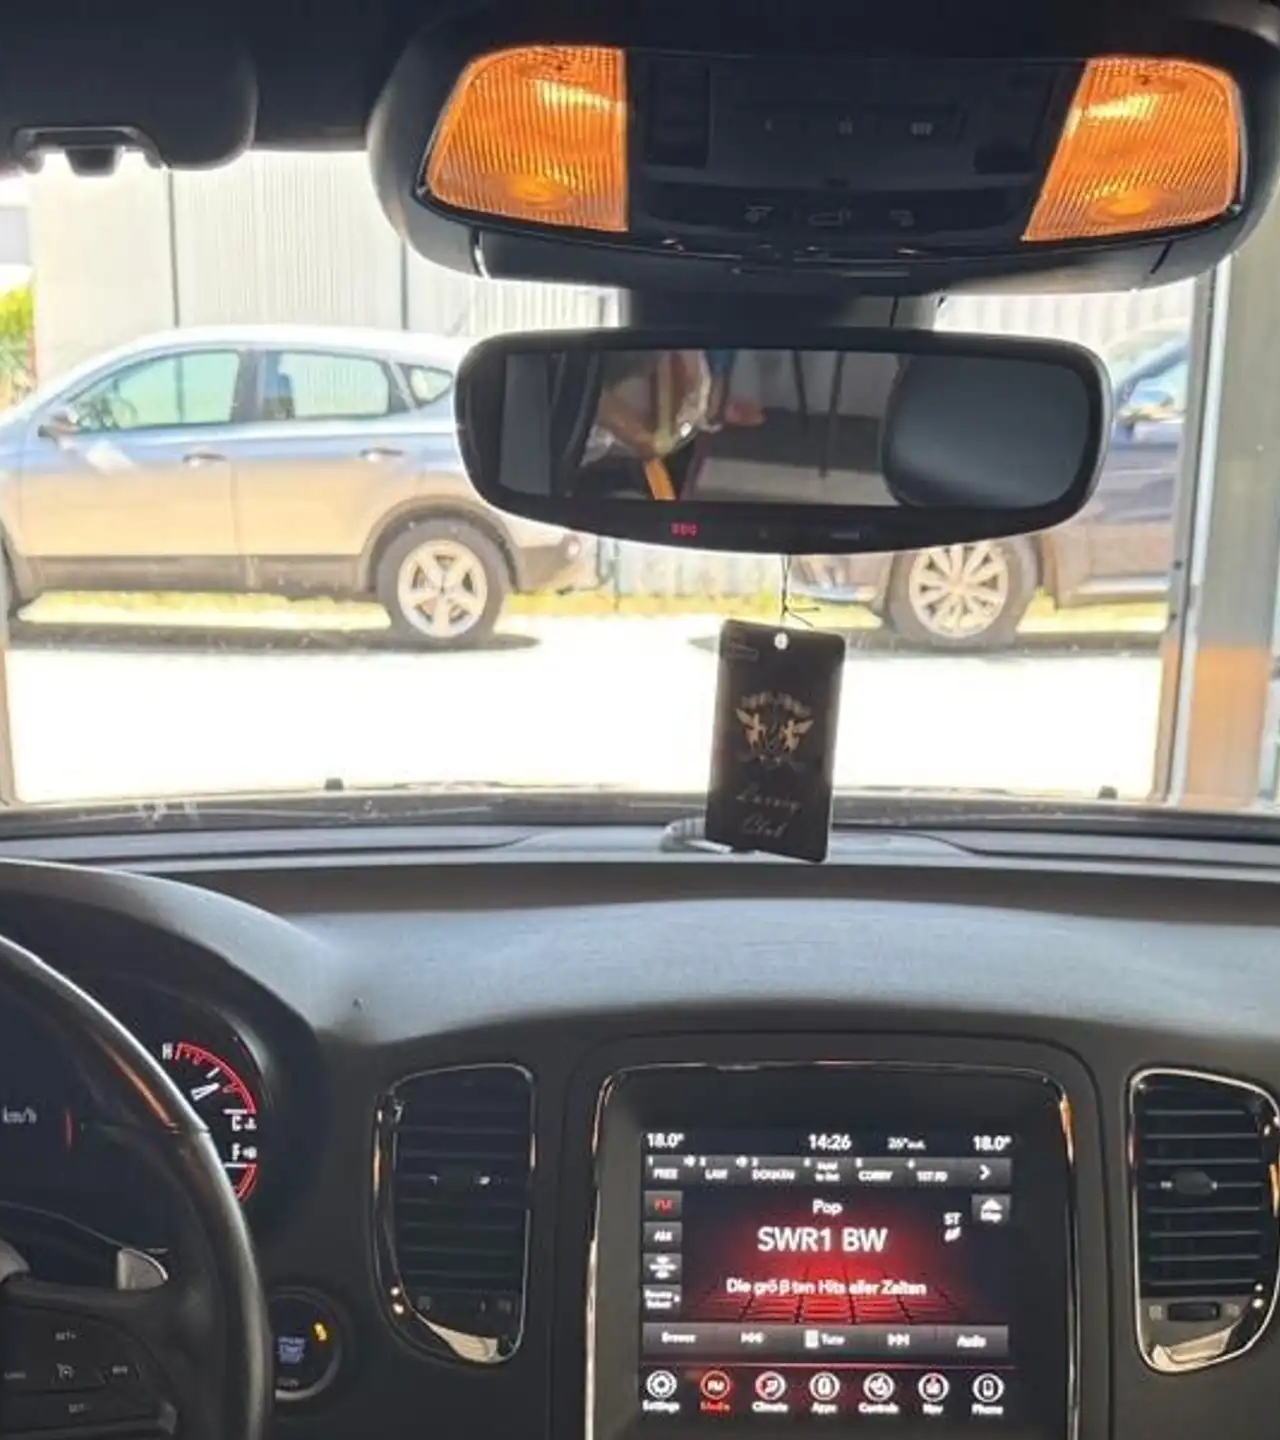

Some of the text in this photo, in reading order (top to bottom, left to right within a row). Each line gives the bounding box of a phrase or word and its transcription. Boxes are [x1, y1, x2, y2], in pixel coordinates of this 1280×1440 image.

[808, 1133, 852, 1151] 14:26
[812, 1198, 844, 1218] Pop
[757, 1226, 888, 1252] SWR1 BW
[726, 1278, 752, 1294] Die
[818, 1279, 846, 1295] Hits
[881, 1280, 927, 1295] Zeiten
[642, 1400, 680, 1414] Settings
[751, 1401, 789, 1413] Climate
[811, 1401, 838, 1415] Apps
[858, 1402, 900, 1414] Controls
[923, 1403, 944, 1415] Nav
[972, 1403, 1004, 1415] Phone
